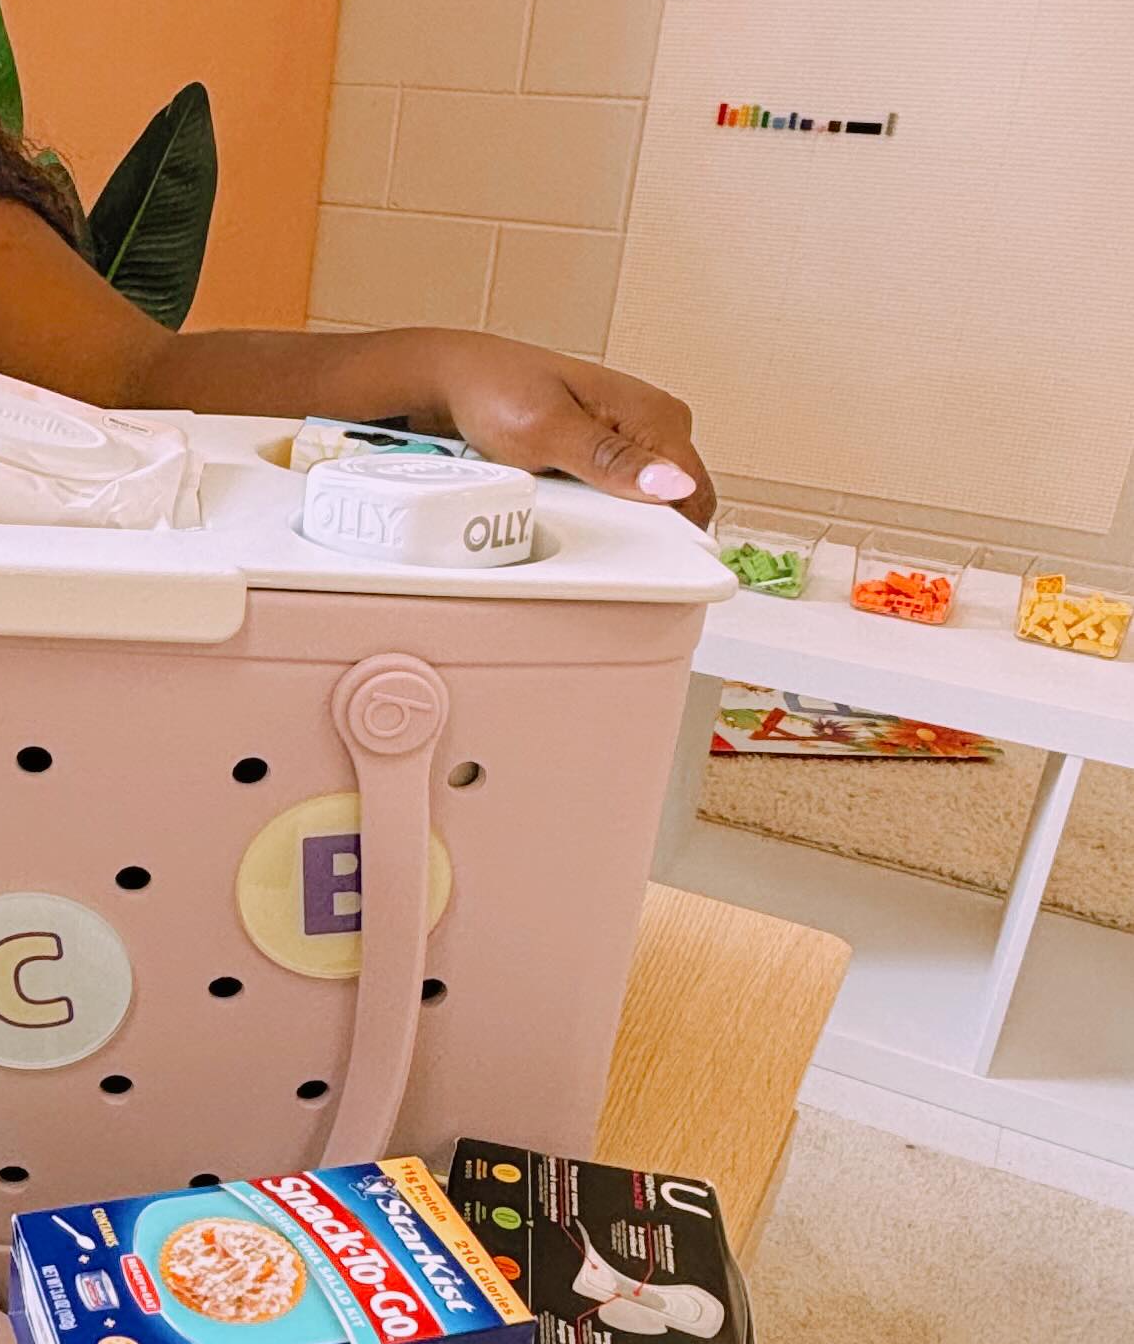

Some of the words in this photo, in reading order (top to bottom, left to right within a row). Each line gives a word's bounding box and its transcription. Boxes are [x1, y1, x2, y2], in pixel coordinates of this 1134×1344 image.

[377, 1197, 477, 1315] StarKist
[415, 1183, 447, 1224] Protein
[473, 1267, 515, 1317] Calories
